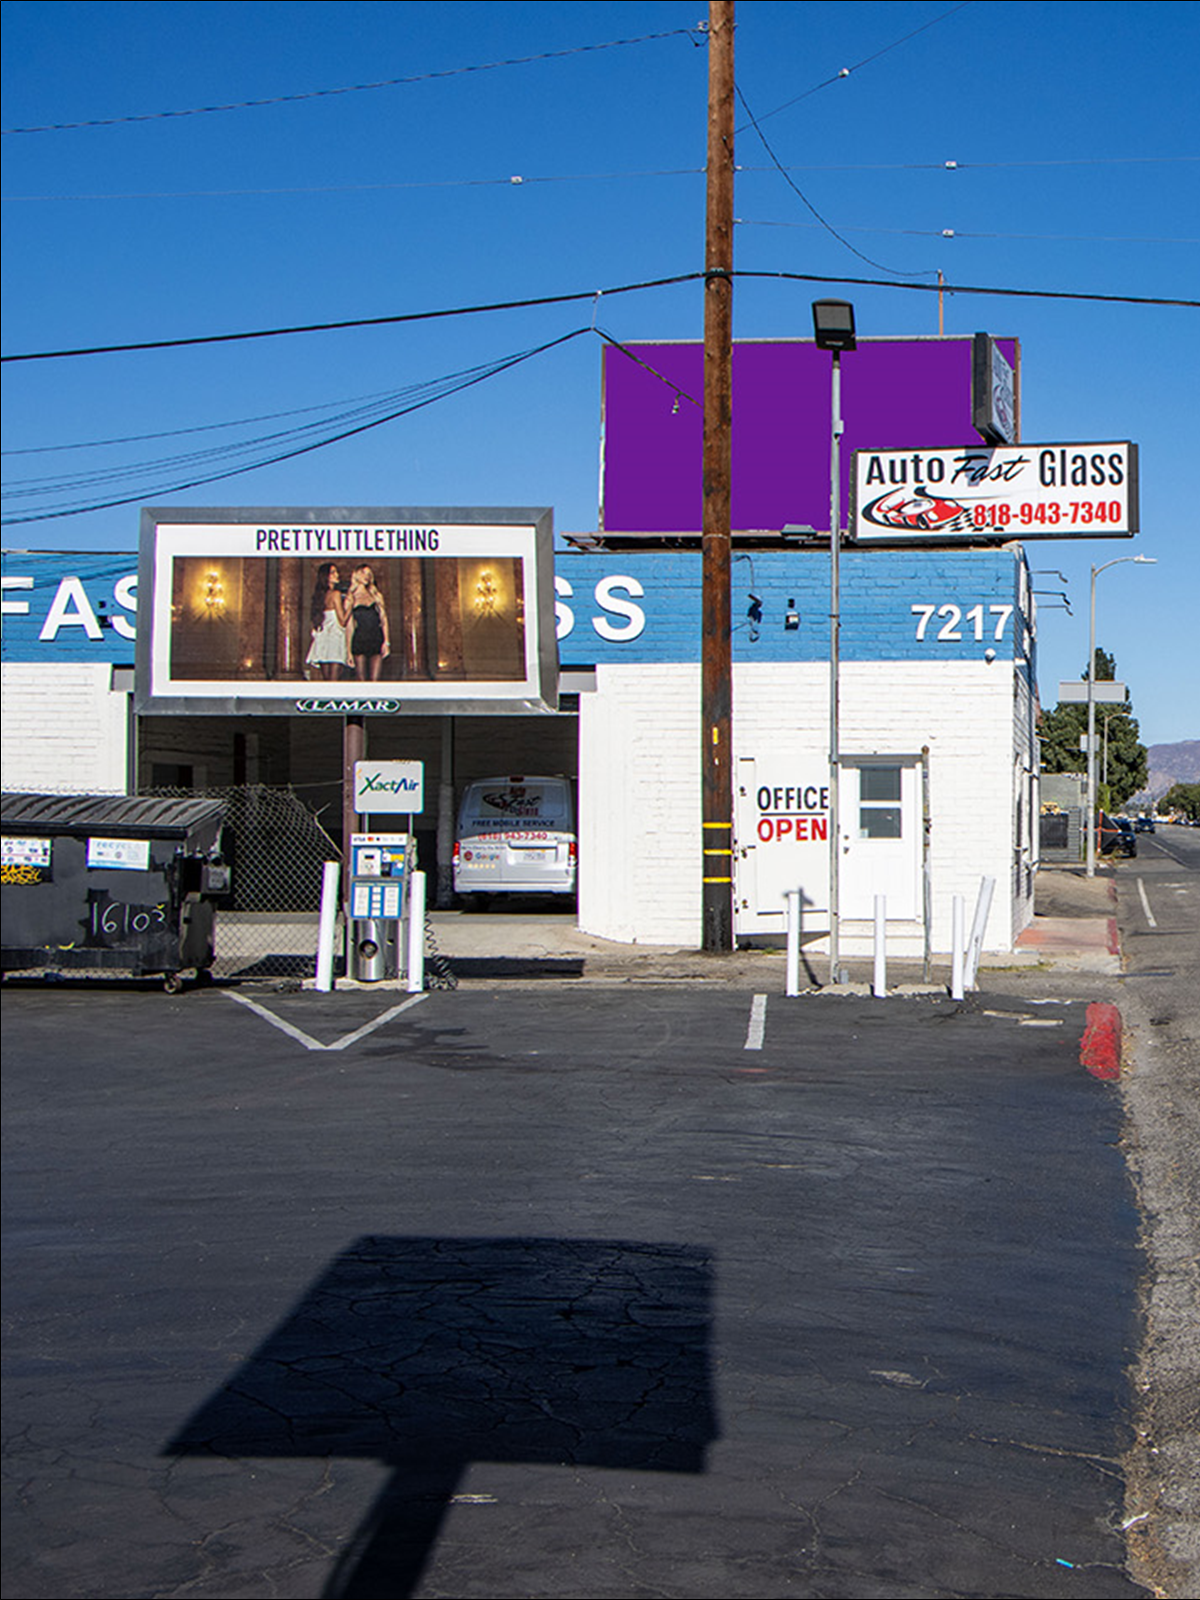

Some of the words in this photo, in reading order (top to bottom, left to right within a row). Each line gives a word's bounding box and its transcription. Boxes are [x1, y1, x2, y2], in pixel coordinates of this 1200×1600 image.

[866, 454, 944, 486] Auto
[950, 455, 1031, 485] Fast
[1039, 449, 1124, 487] Glass
[973, 500, 1122, 526] 818-943-7340
[256, 529, 440, 551] PRETTYLITTLETHING
[911, 604, 1014, 641] 7217
[308, 700, 391, 712] LAMAR
[358, 772, 419, 796] XactAir
[757, 786, 829, 811] OFFICE
[472, 819, 491, 828] FREE
[492, 819, 520, 828] MOBILE
[523, 819, 555, 828] SERVICE
[757, 818, 827, 842] OPEN
